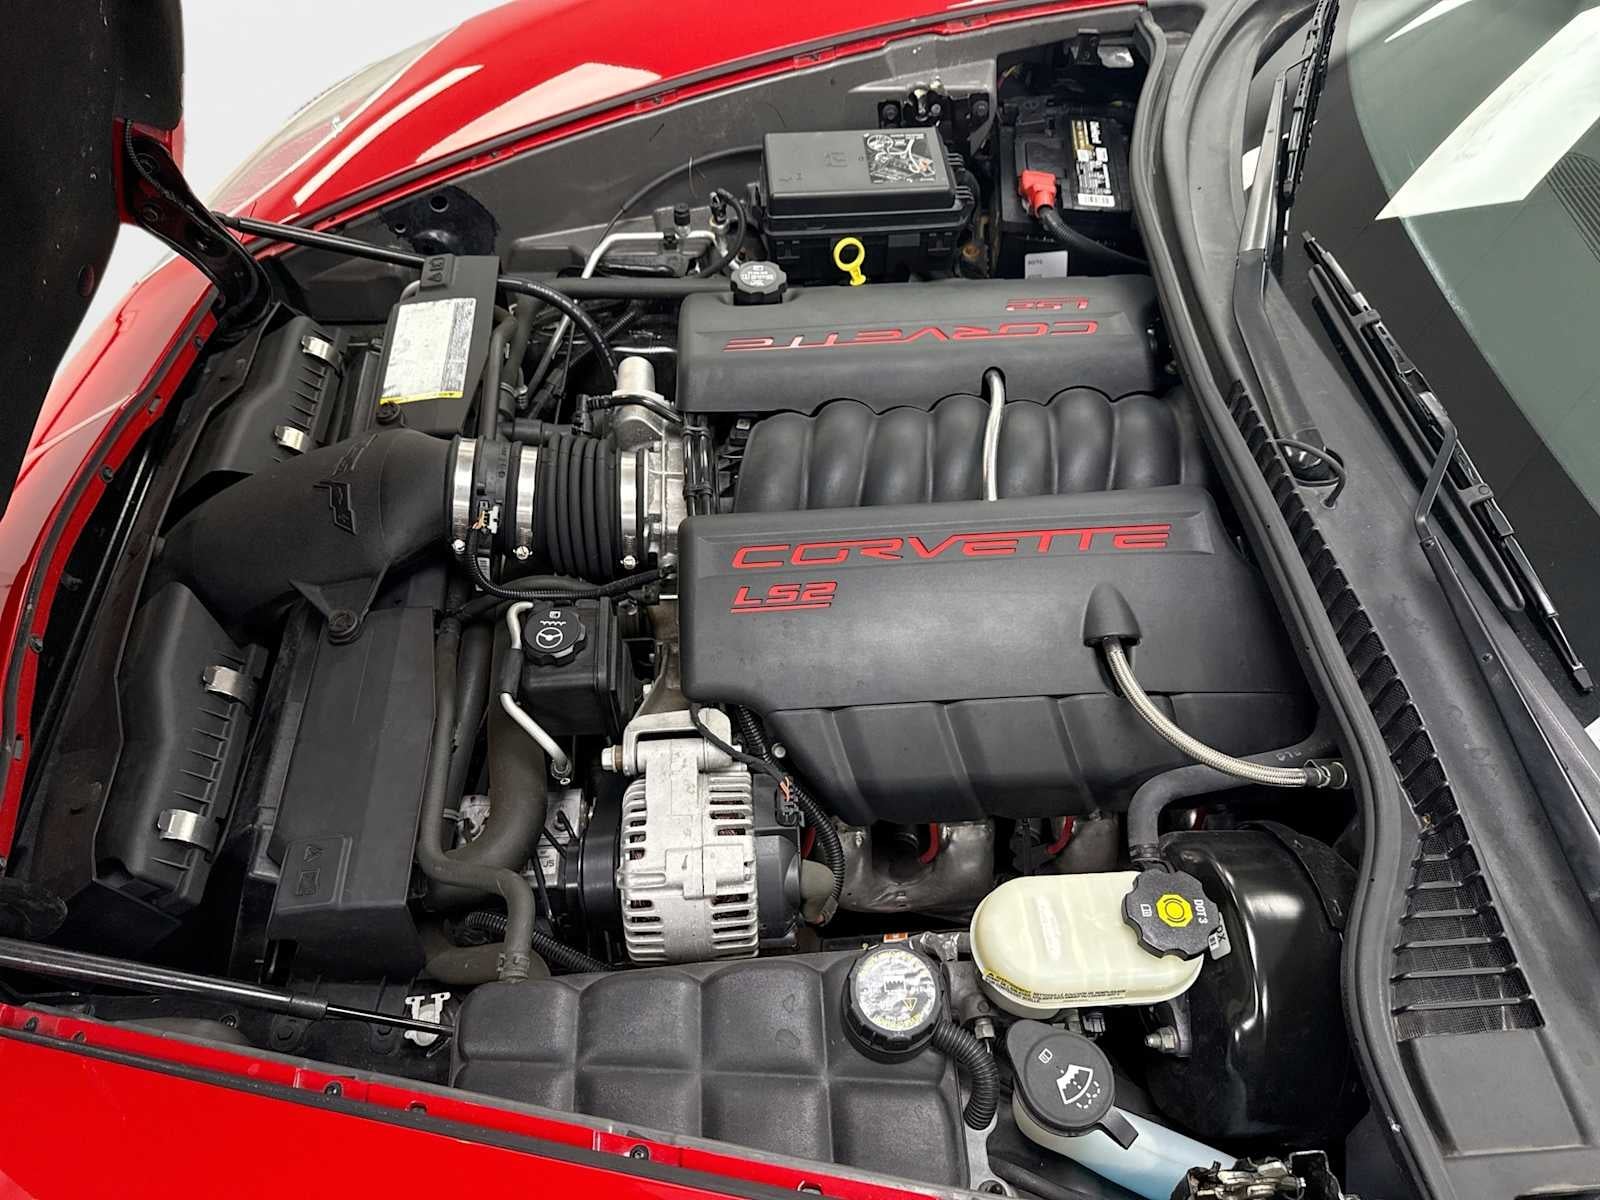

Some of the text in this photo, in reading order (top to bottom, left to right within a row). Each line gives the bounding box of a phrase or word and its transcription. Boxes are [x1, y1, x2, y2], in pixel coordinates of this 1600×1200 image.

[1005, 297, 1088, 312] LS2
[721, 320, 1098, 352] CORVETTE
[731, 524, 1172, 569] CORVETTE
[732, 581, 838, 609] LS2
[1193, 899, 1207, 917] DOT
